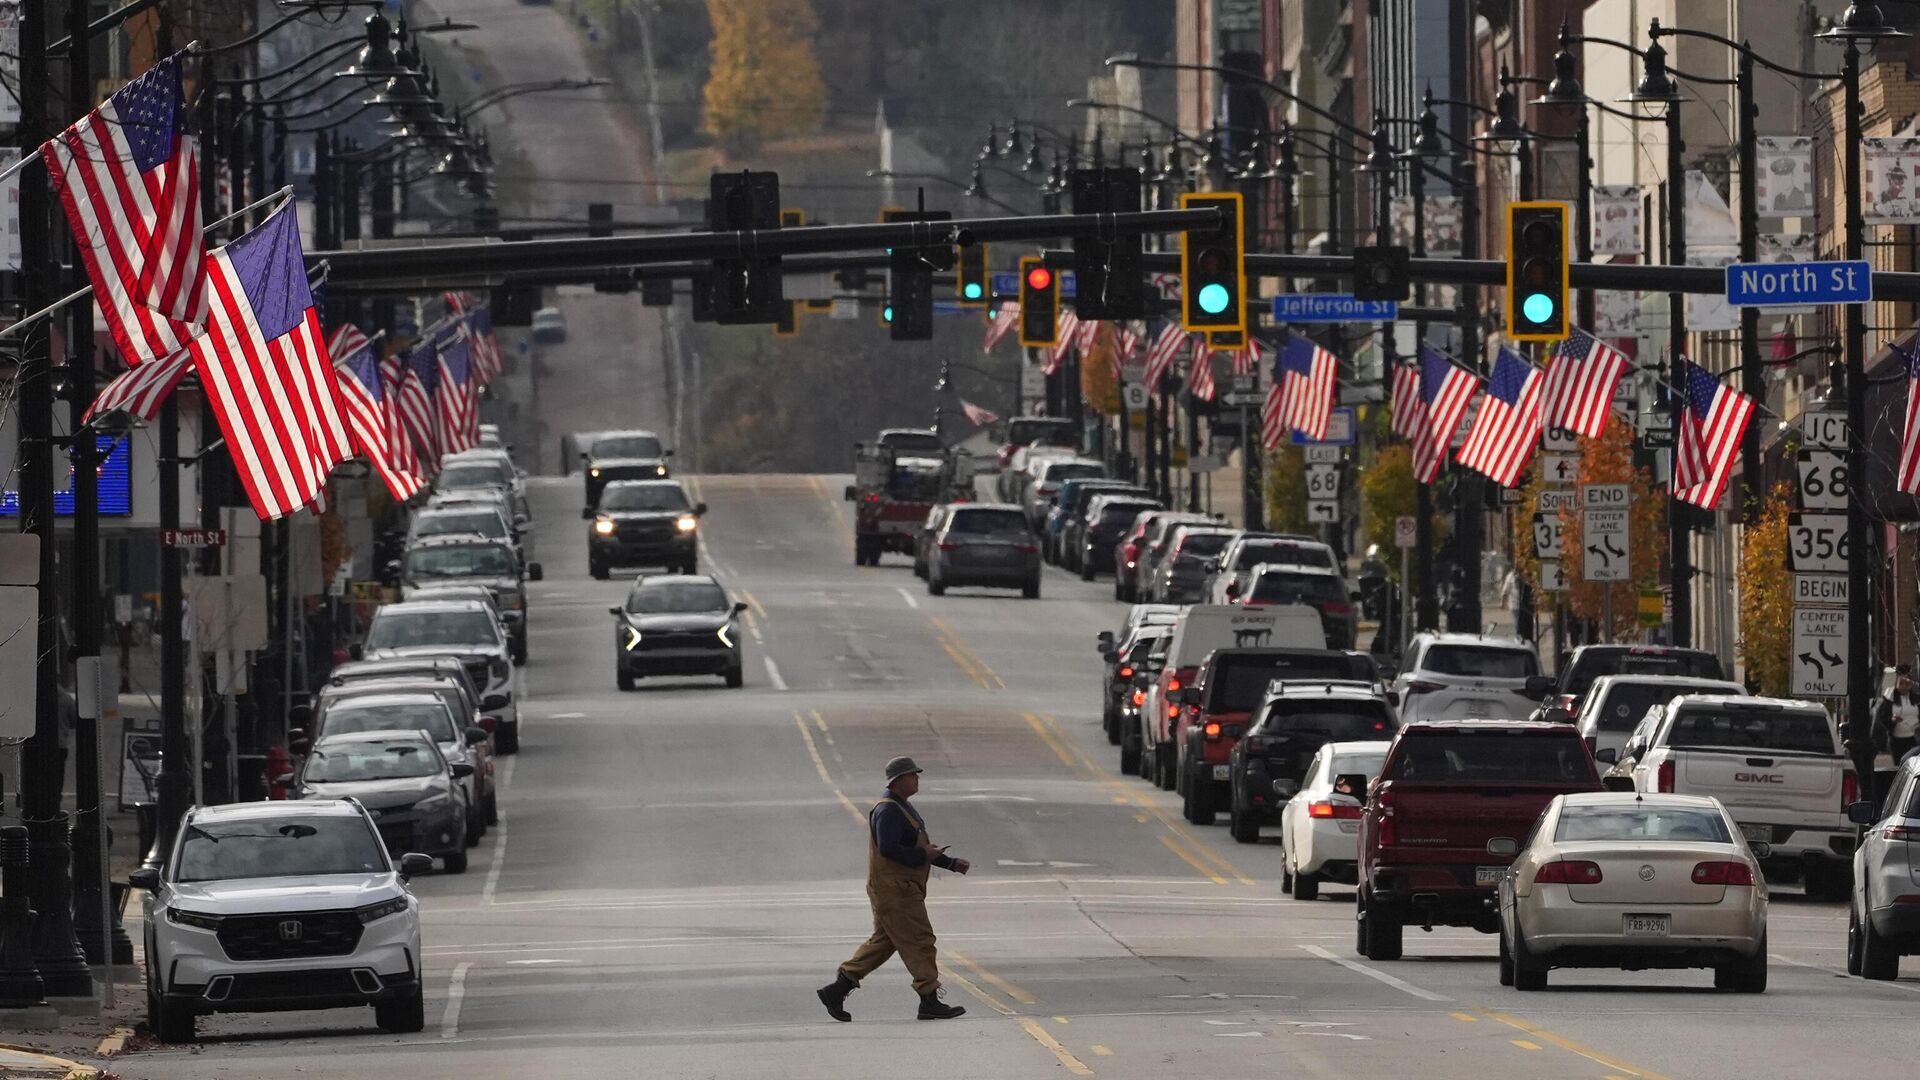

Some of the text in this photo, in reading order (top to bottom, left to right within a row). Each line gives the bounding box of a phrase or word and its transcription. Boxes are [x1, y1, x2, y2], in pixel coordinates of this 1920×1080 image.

[1741, 267, 1857, 294] North St
[1282, 297, 1388, 315] Jefferson St
[1131, 388, 1143, 403] 8
[1806, 417, 1848, 442] JCT
[1311, 472, 1335, 491] 68
[1804, 466, 1848, 497] 68
[1588, 489, 1624, 501] END
[1589, 513, 1624, 521] CENTER
[1594, 522, 1618, 530] LANE
[165, 531, 220, 545] E North St
[1795, 527, 1848, 561] 356
[1594, 569, 1619, 577] ONLY
[1800, 580, 1847, 598] BEGIN
[1800, 612, 1844, 622] CENTER
[1806, 624, 1837, 633] LANE
[1804, 682, 1836, 692] ONLY
[1735, 772, 1784, 784] GMC
[1478, 871, 1507, 881] ZPT-08
